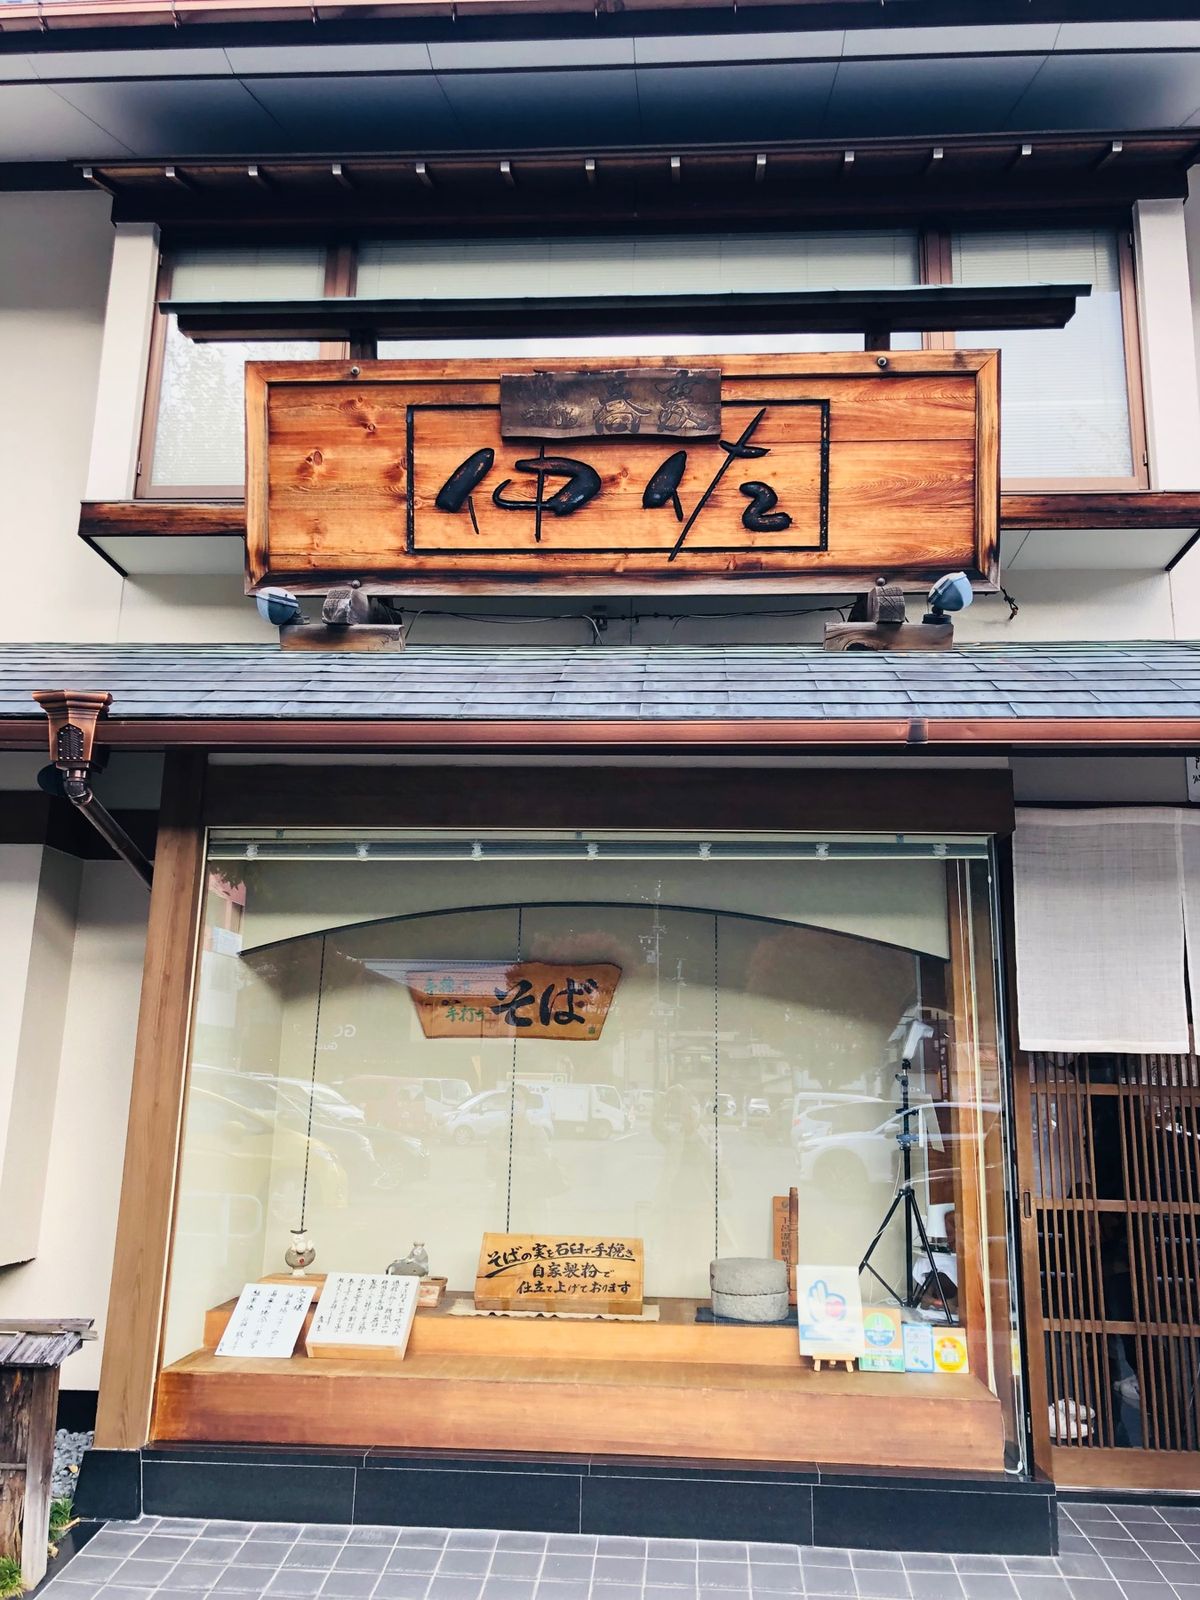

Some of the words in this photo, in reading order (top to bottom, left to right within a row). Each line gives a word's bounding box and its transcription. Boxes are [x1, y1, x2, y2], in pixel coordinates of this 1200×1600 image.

[490, 977, 598, 1027] そば
[533, 1262, 614, 1278] 自家製粉で
[516, 1280, 631, 1295] 仕立て上げております
